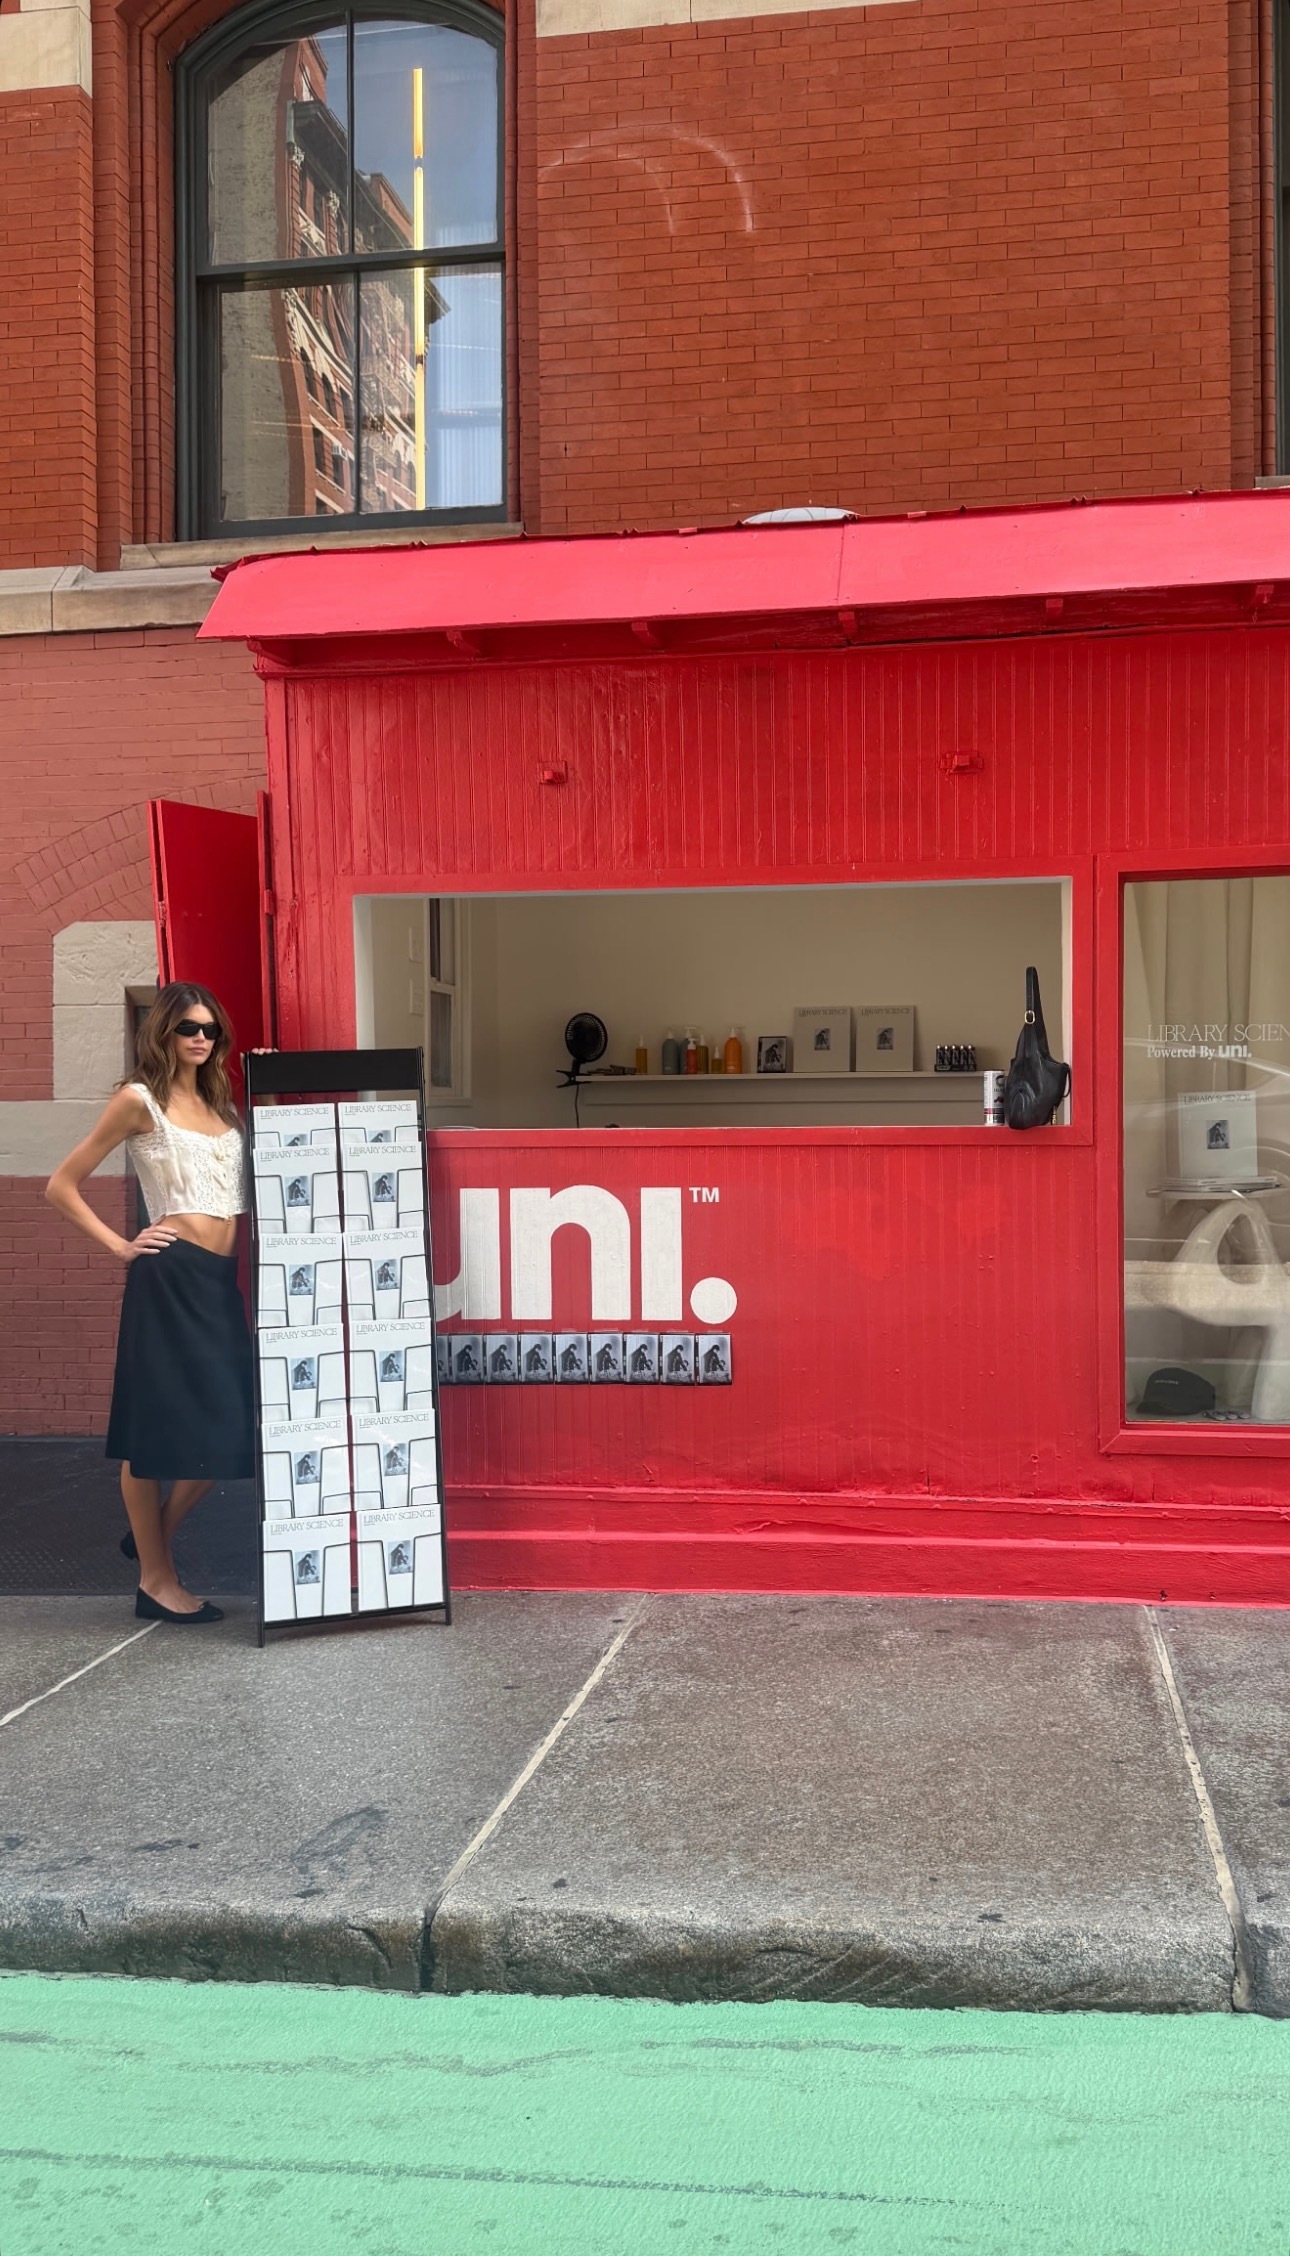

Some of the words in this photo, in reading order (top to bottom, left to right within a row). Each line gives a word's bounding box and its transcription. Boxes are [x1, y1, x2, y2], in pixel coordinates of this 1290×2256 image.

[1147, 1024, 1228, 1042] LIBRARY
[1147, 1045, 1196, 1058] Powered
[1199, 1045, 1215, 1060] By
[1218, 1045, 1252, 1058] uni.
[260, 1109, 292, 1117] LIBRARY
[293, 1107, 329, 1116] SCIENCE
[344, 1104, 376, 1113] LIBRARY
[377, 1104, 412, 1112] SCIENCE
[260, 1151, 292, 1160] LIBRARY
[293, 1148, 330, 1157] SCIENCE
[349, 1147, 380, 1155] LIBRARY
[381, 1145, 417, 1154] SCIENCE
[266, 1237, 299, 1246] LIBRARY
[299, 1237, 337, 1245] SCIENCE
[350, 1233, 382, 1243] LIBRARY
[383, 1231, 418, 1240] SCIENCE
[356, 1324, 388, 1333] LIBRARY
[389, 1322, 425, 1331] SCIENCE
[266, 1332, 299, 1341] LIBRARY
[300, 1327, 337, 1337] SCIENCE
[359, 1416, 392, 1428] LIBRARY
[393, 1414, 429, 1423] SCIENCE
[269, 1425, 302, 1435] LIBRARY
[304, 1420, 341, 1430] SCIENCE
[363, 1513, 396, 1523] LIBRARY
[398, 1510, 435, 1520] SCIENCE
[270, 1522, 304, 1532] LIBRARY
[306, 1519, 343, 1529] SCIENCE
